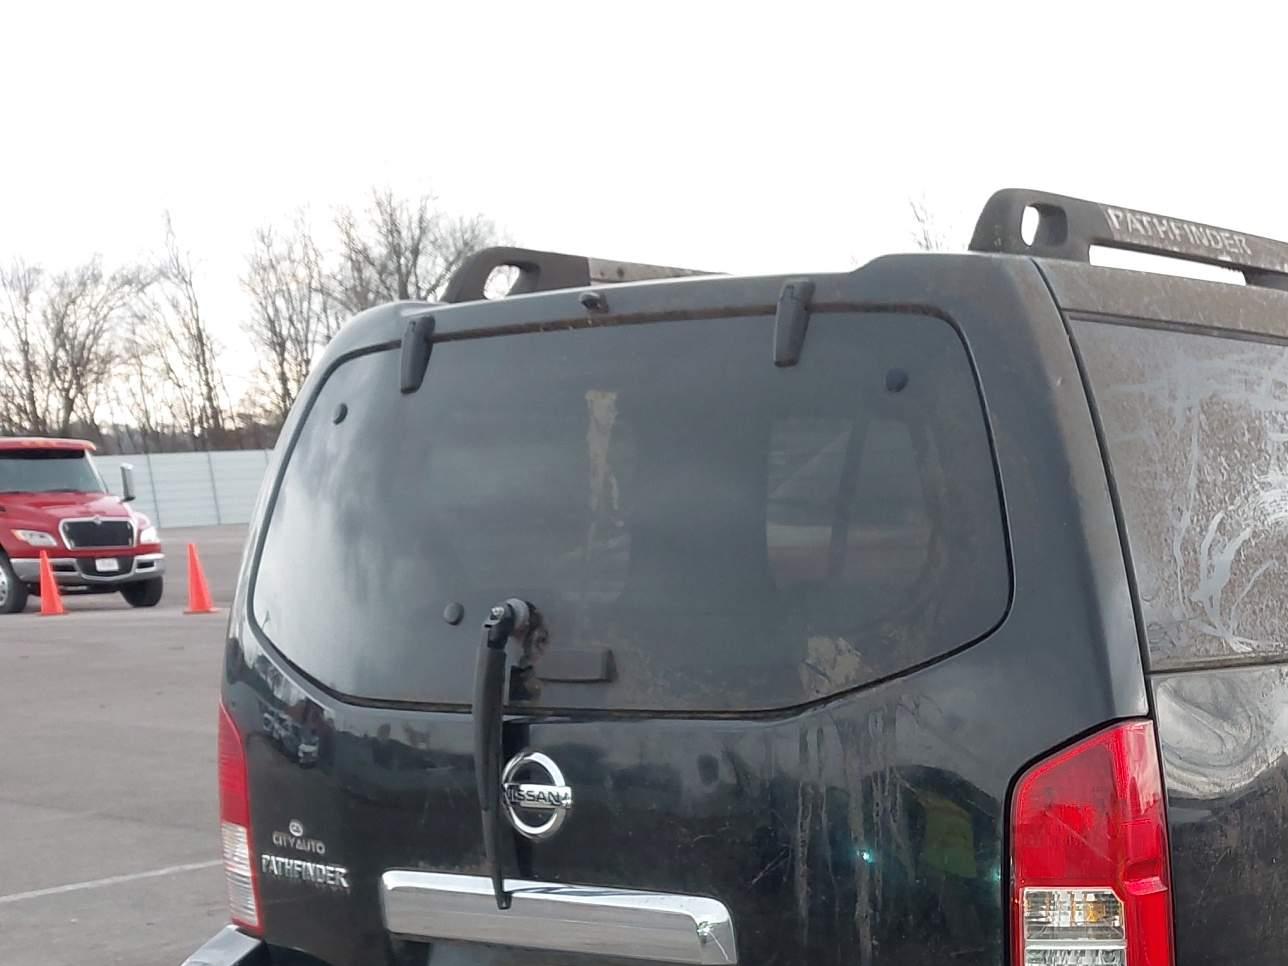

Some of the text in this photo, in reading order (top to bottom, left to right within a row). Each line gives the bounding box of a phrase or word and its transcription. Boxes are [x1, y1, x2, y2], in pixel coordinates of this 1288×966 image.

[1105, 206, 1252, 255] PATHFINDER
[504, 788, 563, 807] NISSAN
[261, 854, 349, 888] PATHFINDER
